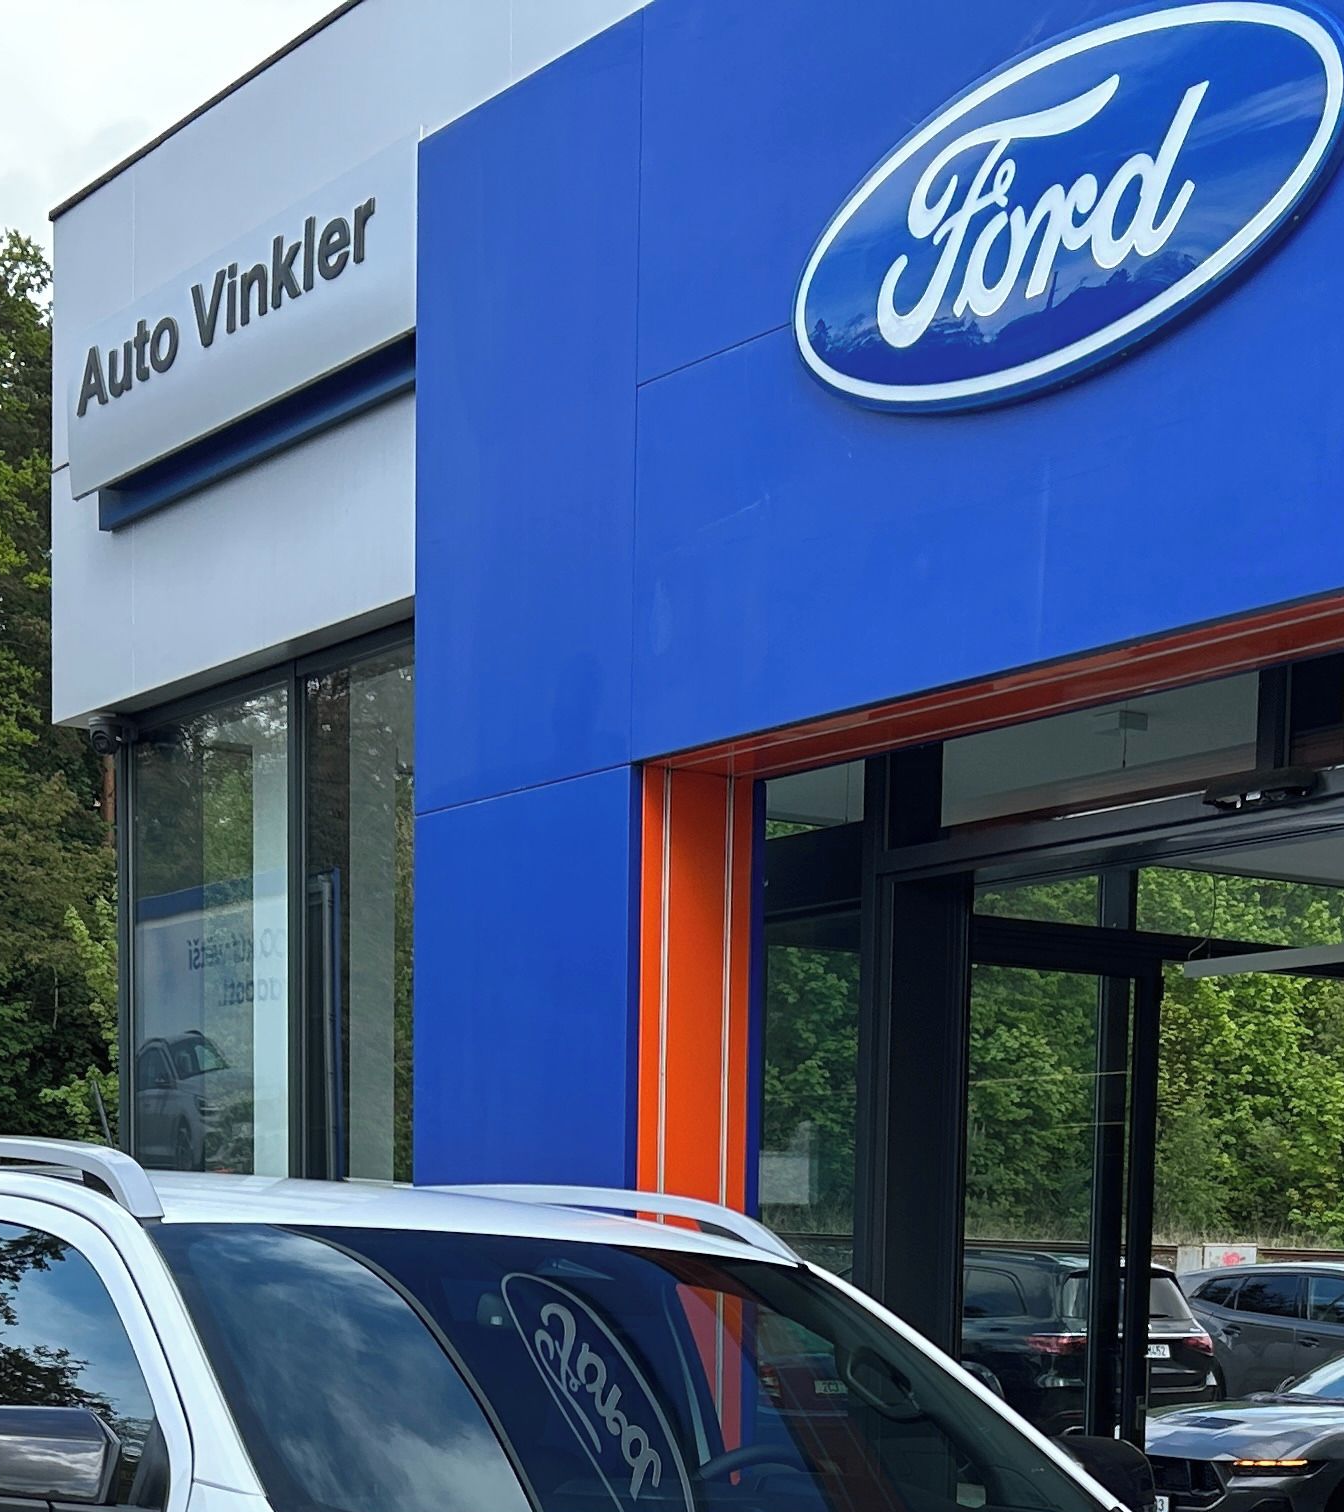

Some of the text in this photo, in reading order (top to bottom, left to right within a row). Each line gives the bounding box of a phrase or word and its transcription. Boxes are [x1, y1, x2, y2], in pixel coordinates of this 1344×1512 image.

[76, 196, 375, 417] Auto Vinkler
[875, 72, 1211, 349] Ford
